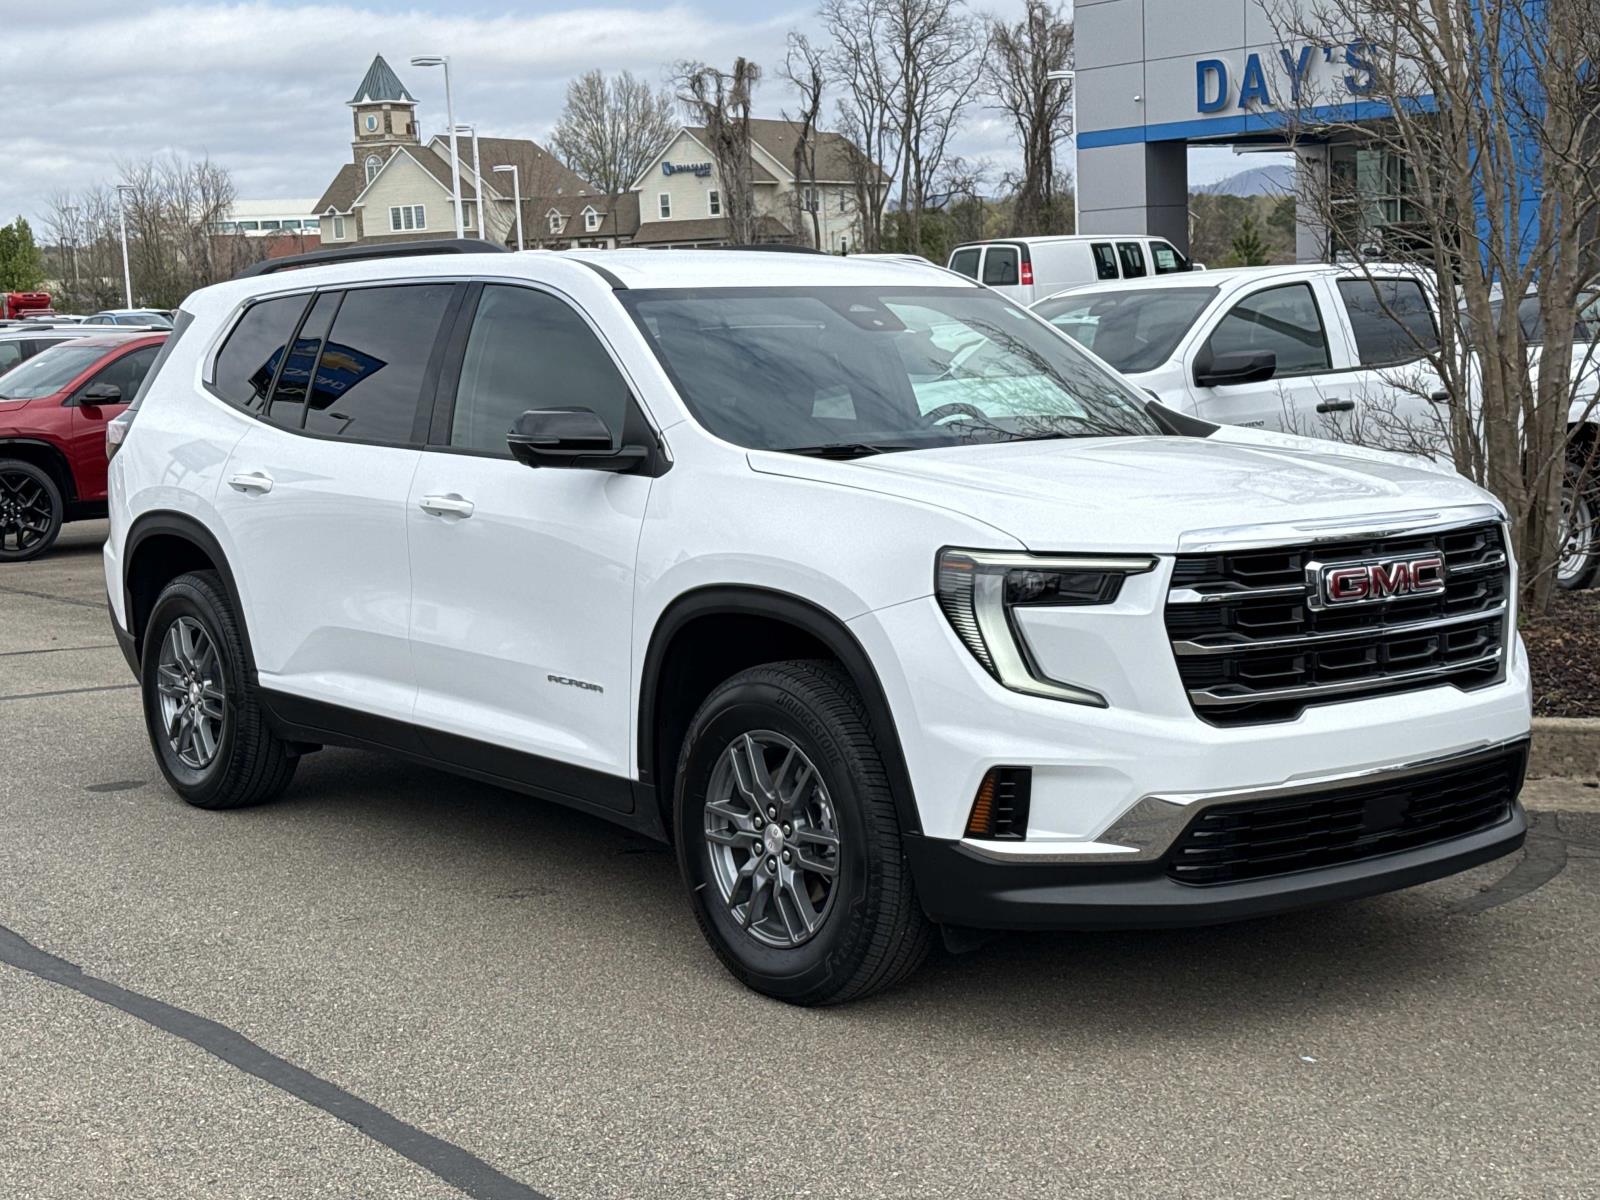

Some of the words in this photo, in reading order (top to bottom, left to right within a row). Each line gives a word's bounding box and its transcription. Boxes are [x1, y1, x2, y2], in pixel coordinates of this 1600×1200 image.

[1196, 38, 1377, 113] DAY'S
[1326, 558, 1444, 602] GMC
[547, 674, 604, 693] ACADIA
[776, 691, 842, 767] BRIDGESTONE
